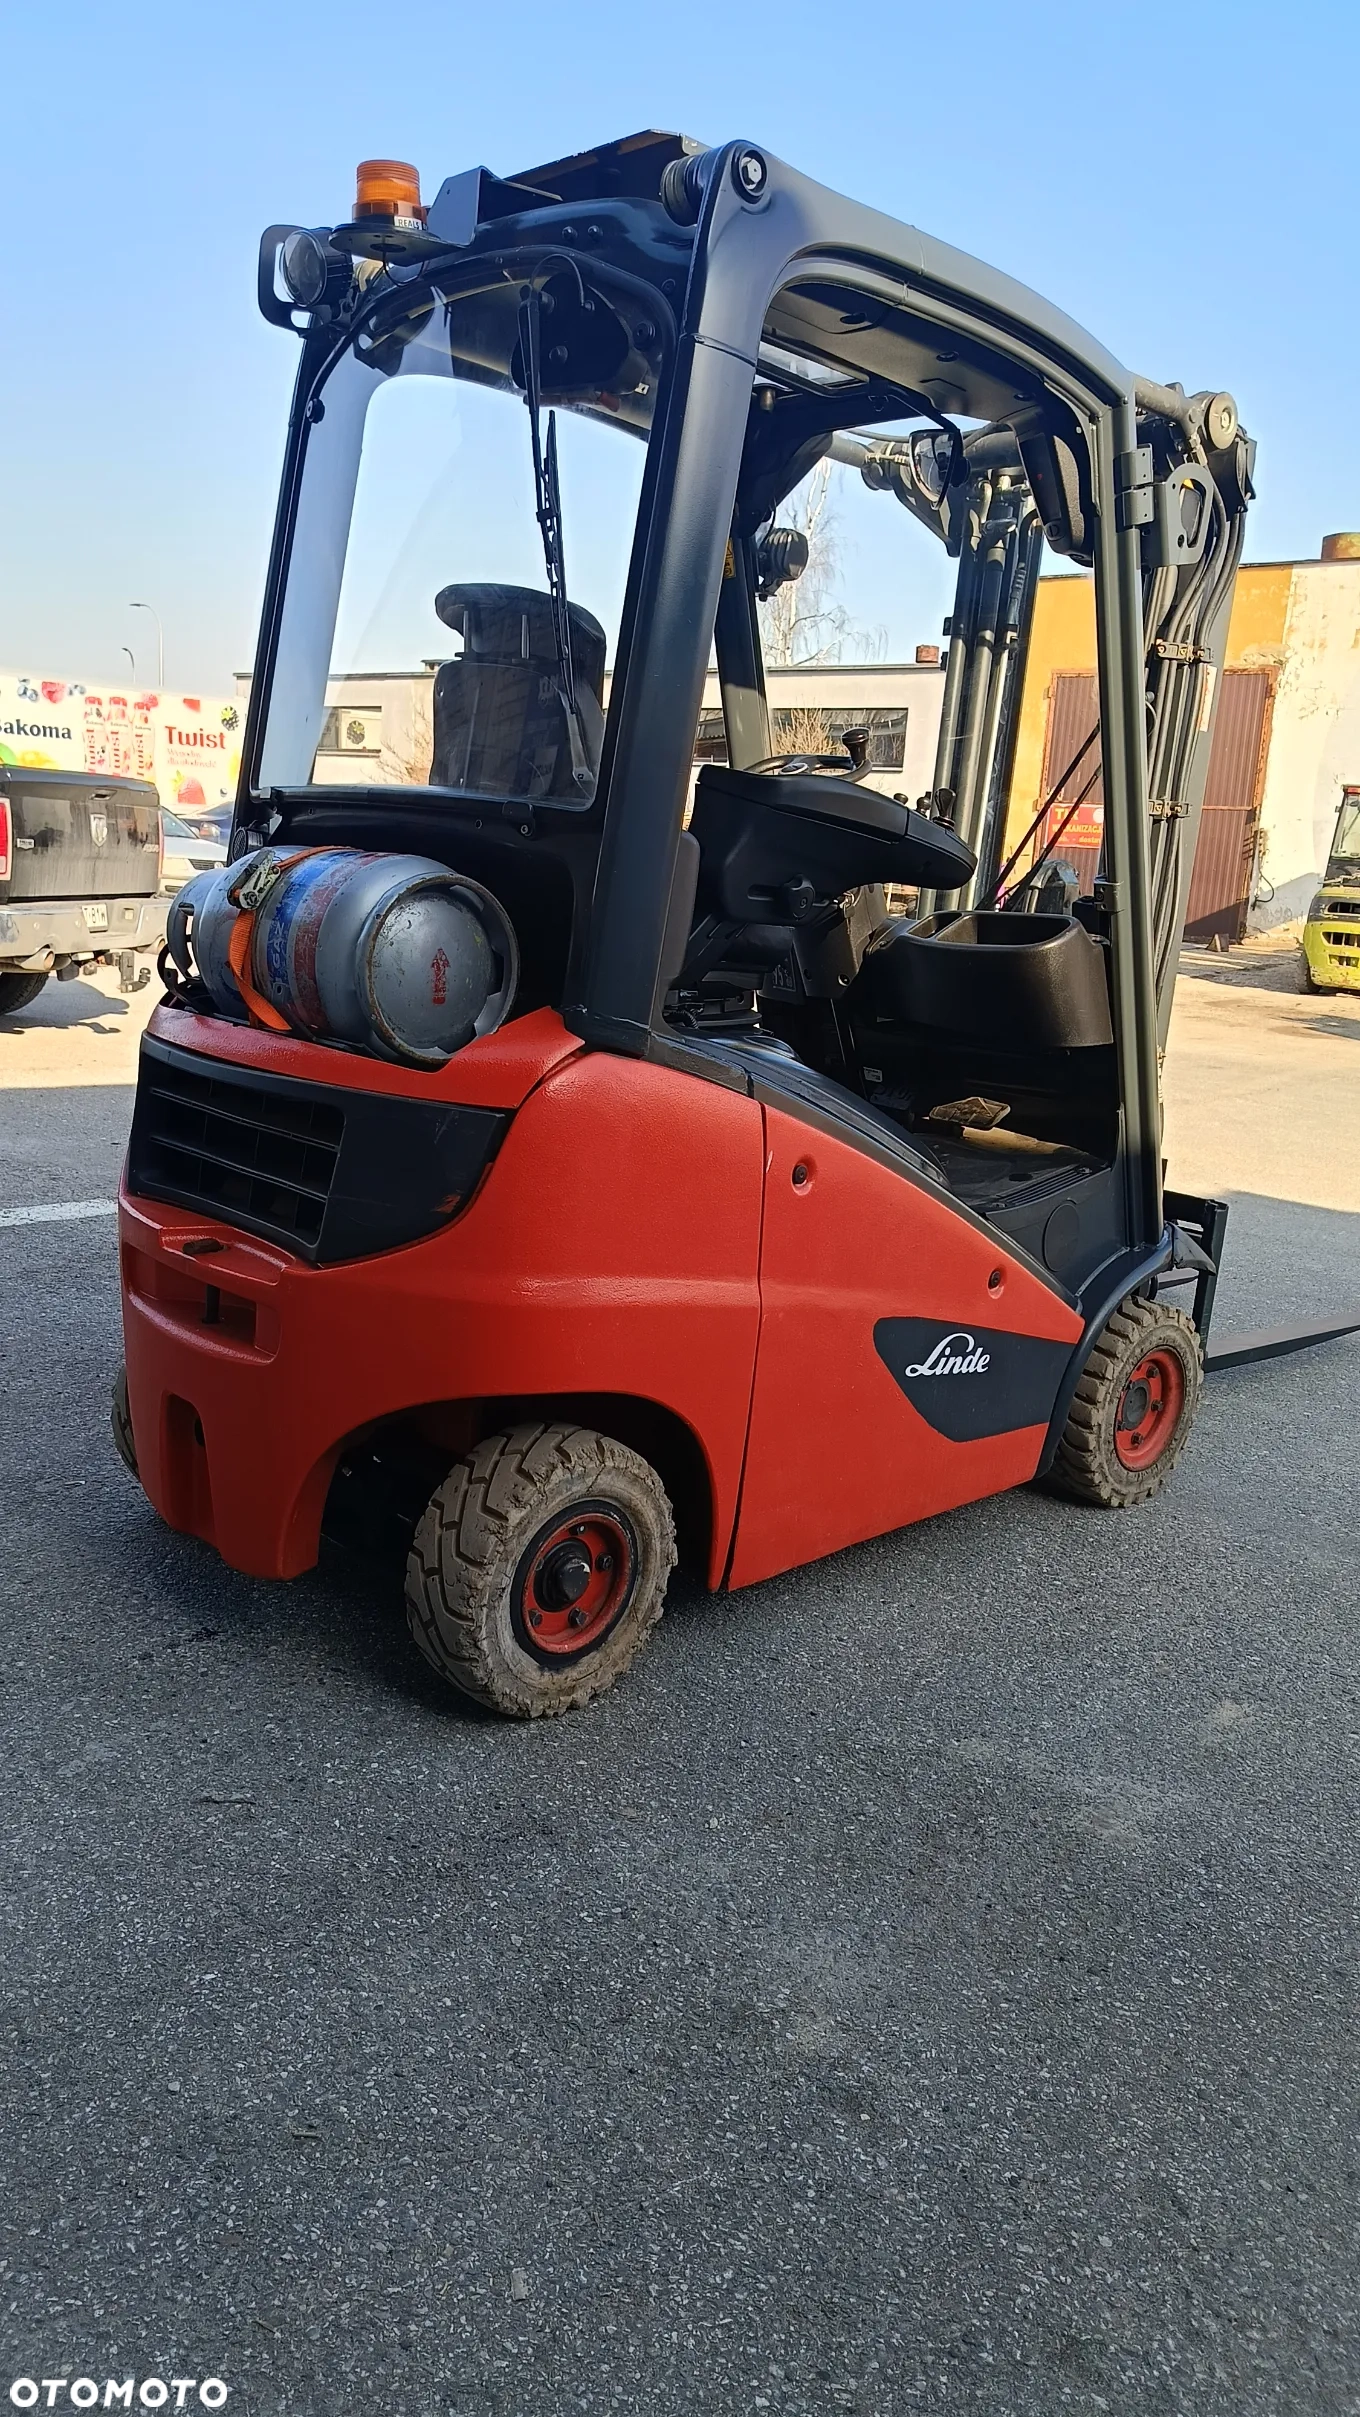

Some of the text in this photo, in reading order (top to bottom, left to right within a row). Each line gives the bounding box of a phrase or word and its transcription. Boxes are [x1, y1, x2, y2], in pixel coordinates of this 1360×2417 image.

[0, 718, 72, 740] akoma
[164, 725, 226, 749] Twist
[905, 1332, 991, 1378] Linde
